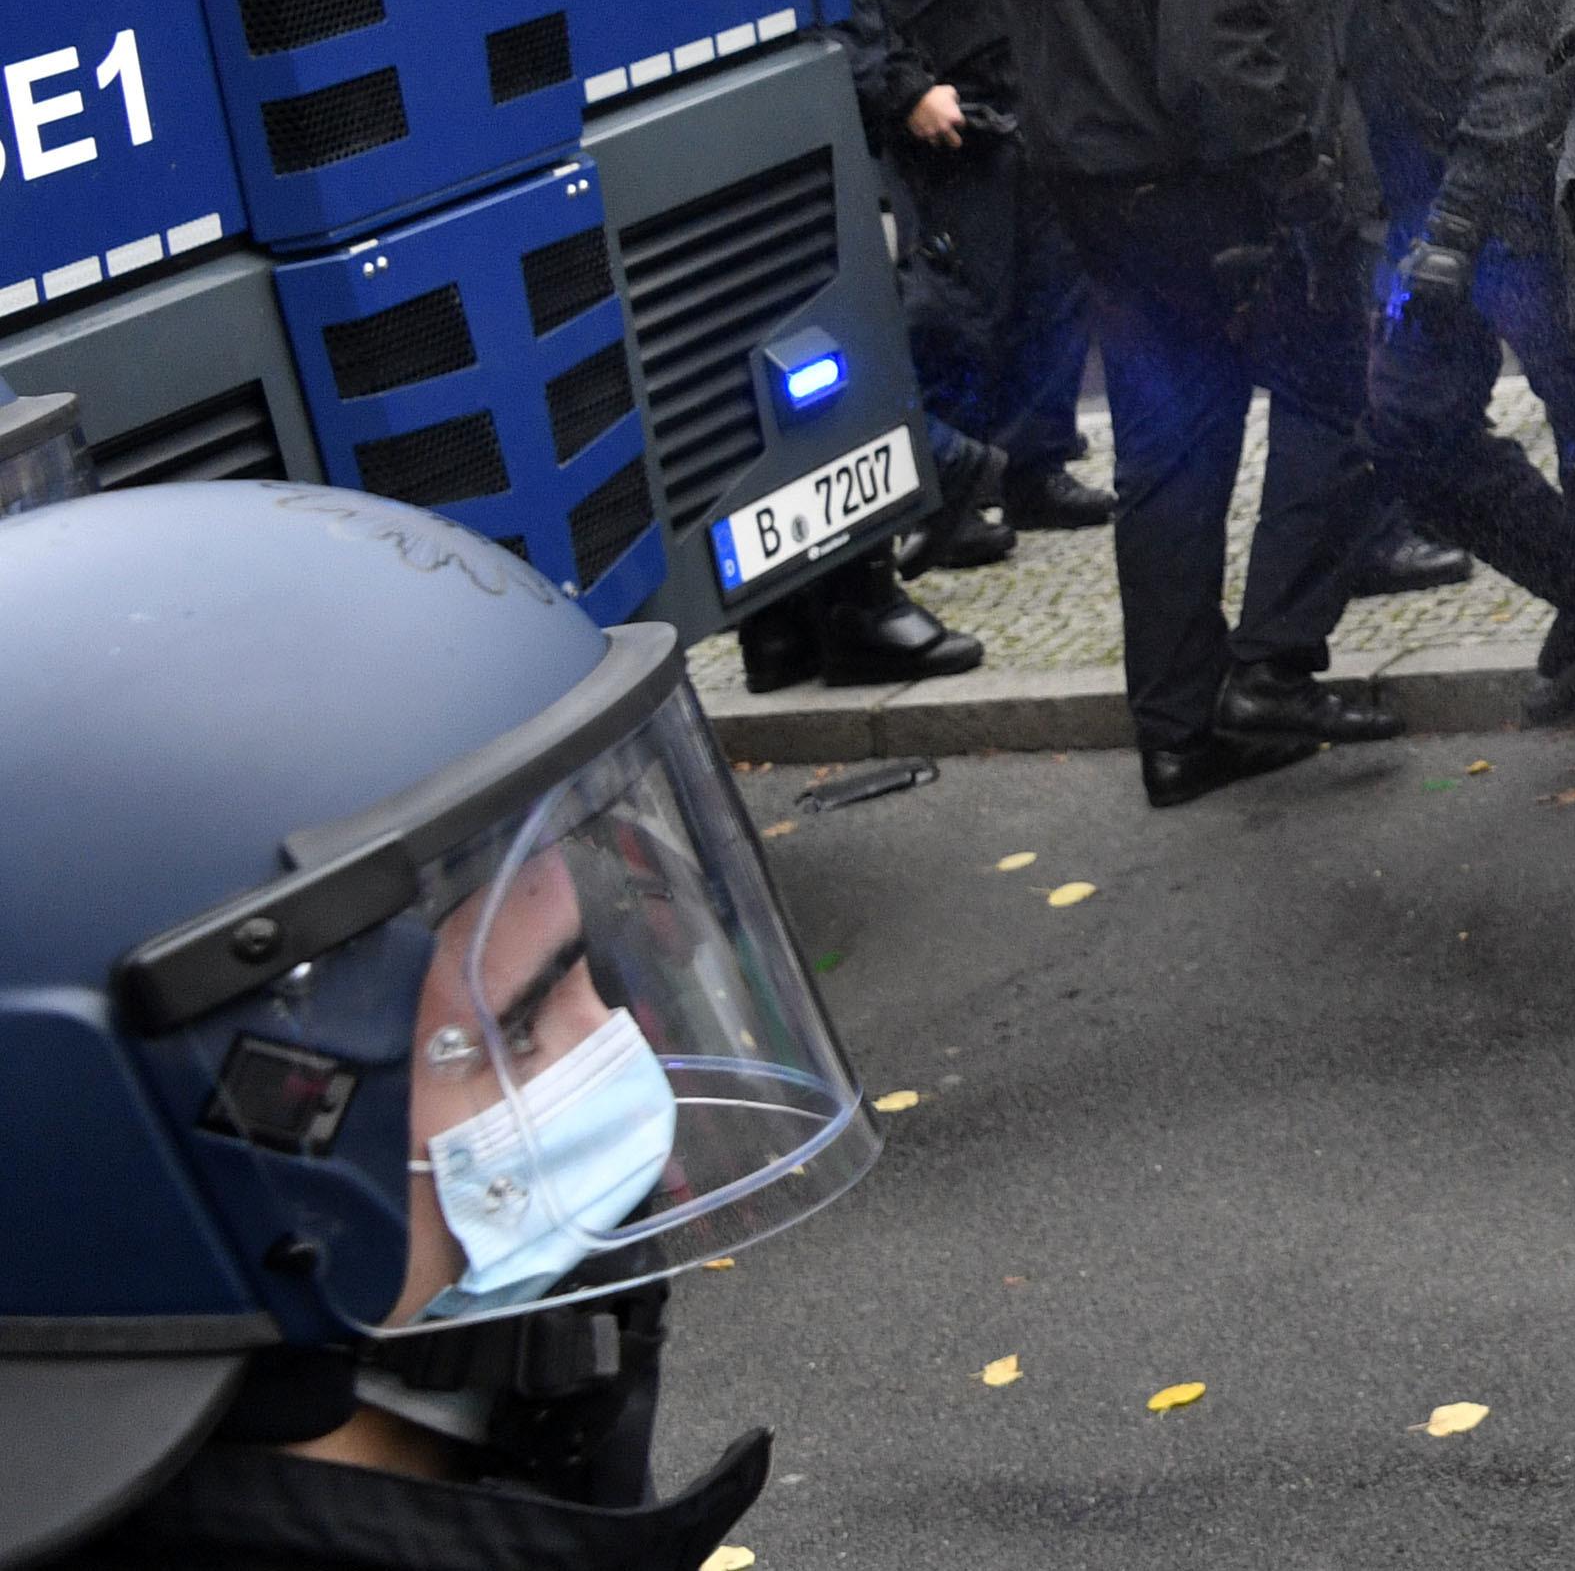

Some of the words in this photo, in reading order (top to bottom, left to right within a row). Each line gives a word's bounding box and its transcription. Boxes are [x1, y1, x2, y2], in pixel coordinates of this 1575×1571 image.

[0, 29, 154, 182] E1
[756, 506, 782, 559] B
[815, 443, 892, 527] 7207
